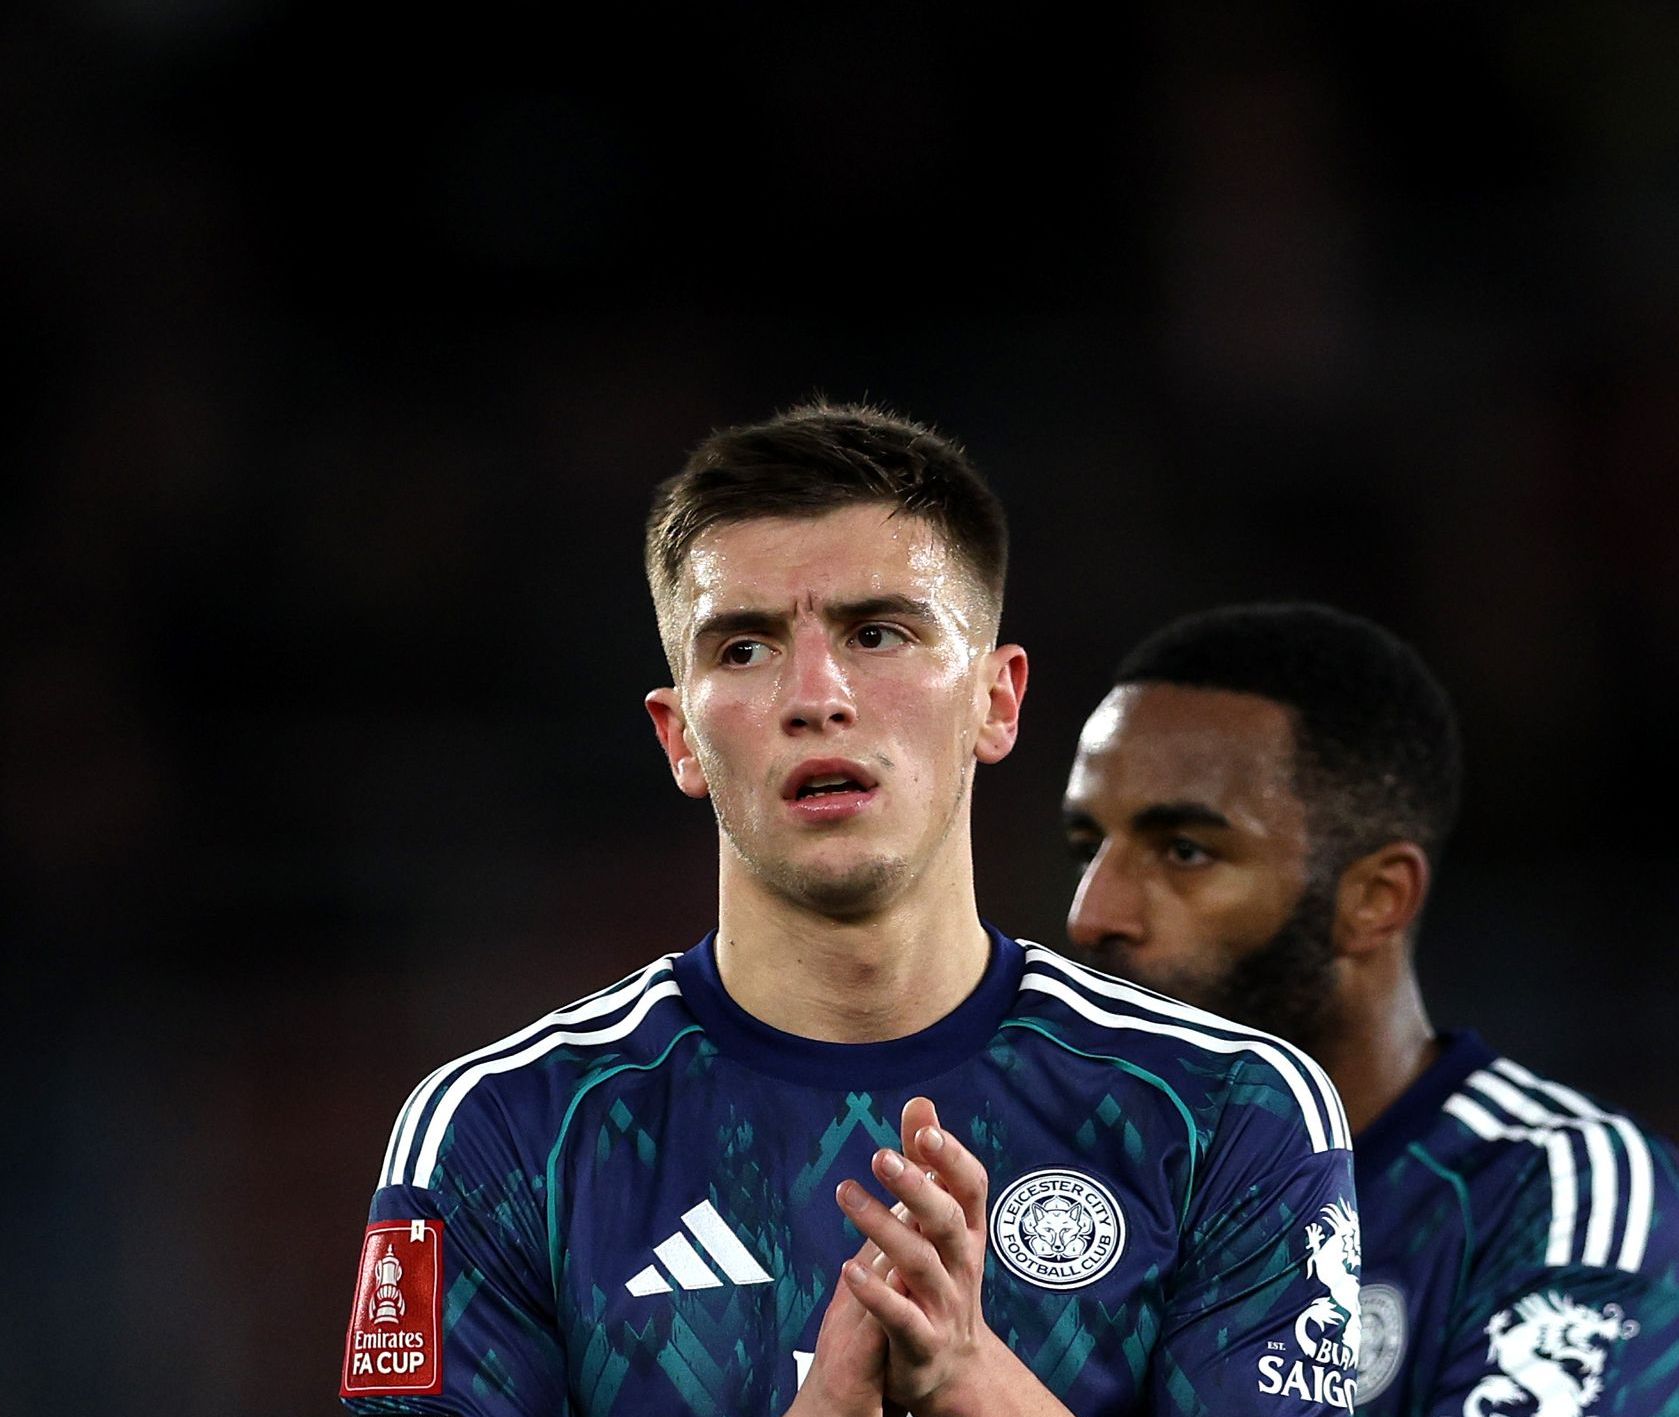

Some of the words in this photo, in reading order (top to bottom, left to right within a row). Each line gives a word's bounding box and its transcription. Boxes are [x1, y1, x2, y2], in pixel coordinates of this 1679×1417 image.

[1003, 1180, 1084, 1225] LEICESTER
[1085, 1193, 1112, 1227] CITY
[1003, 1233, 1081, 1277] FOOTBALL
[1081, 1235, 1111, 1270] CLUB
[354, 1328, 424, 1350] Emirates
[352, 1352, 373, 1375] FA
[376, 1351, 425, 1374] CUP
[1257, 1355, 1358, 1415] SAIGO
